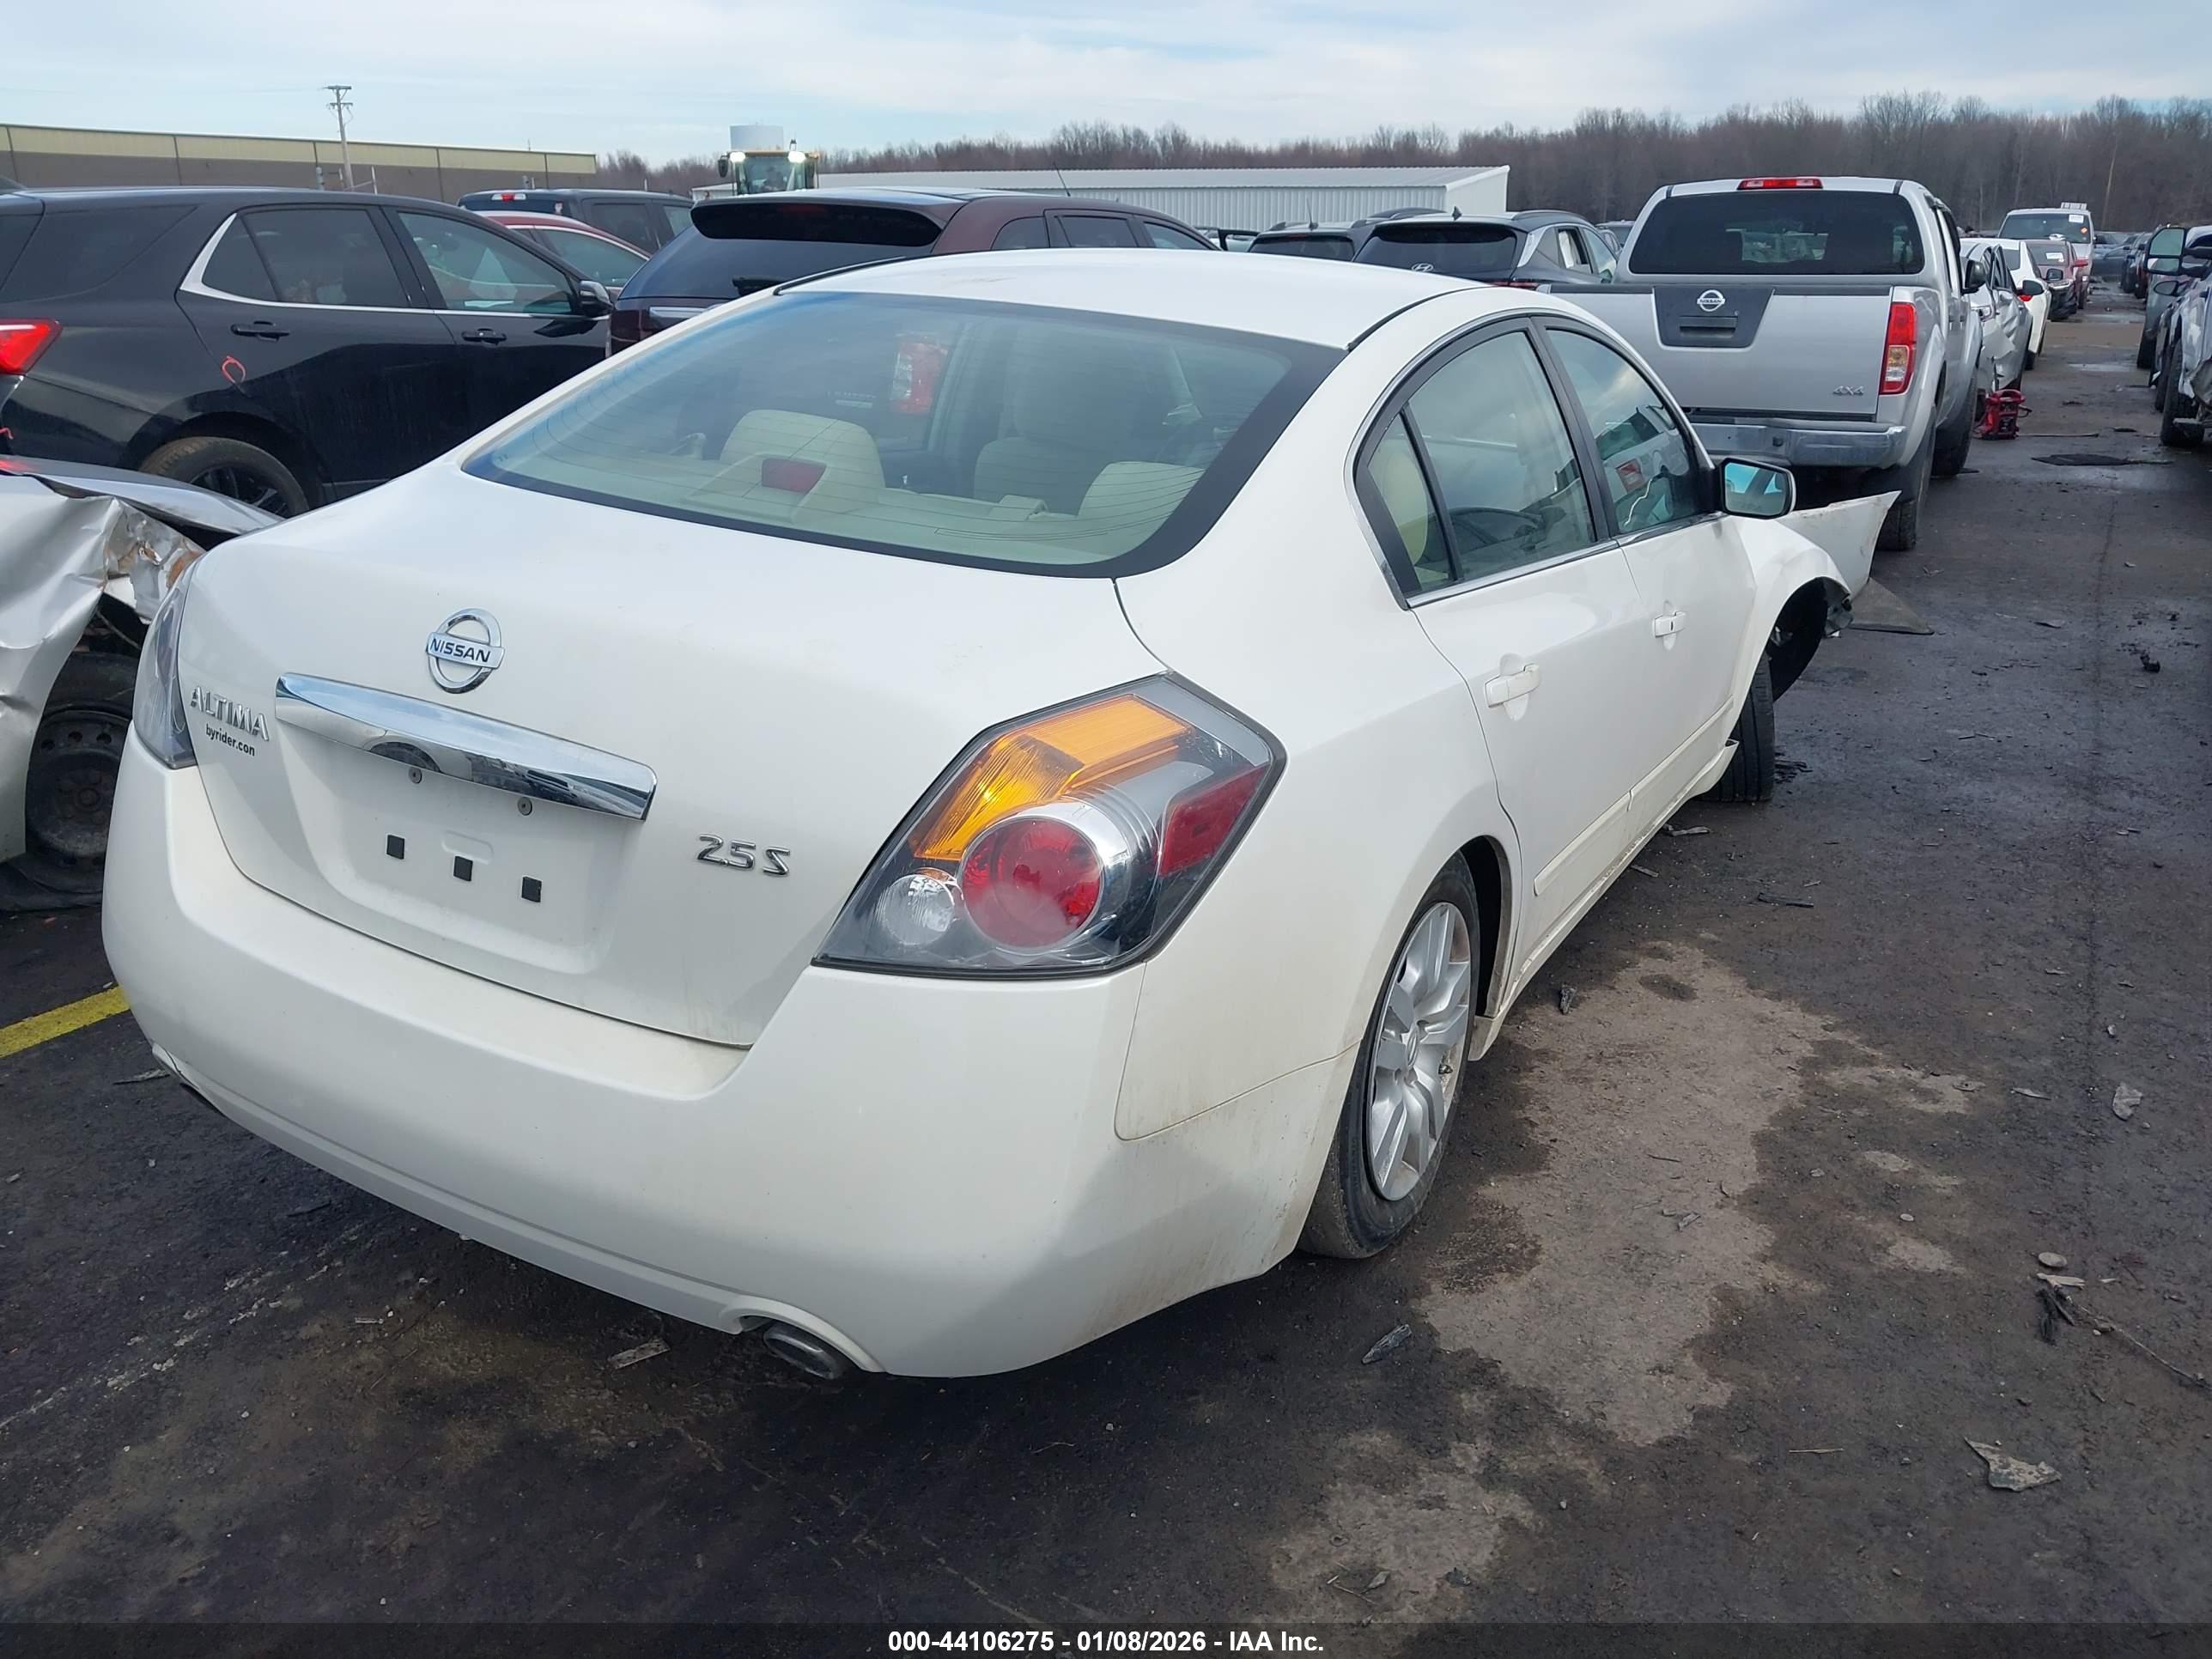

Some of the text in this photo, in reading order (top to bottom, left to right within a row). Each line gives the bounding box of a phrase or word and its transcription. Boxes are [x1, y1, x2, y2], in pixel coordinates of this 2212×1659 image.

[429, 638, 491, 663] NISSAN
[191, 686, 270, 742] ALTIMA
[697, 833, 791, 875] 2.5 S
